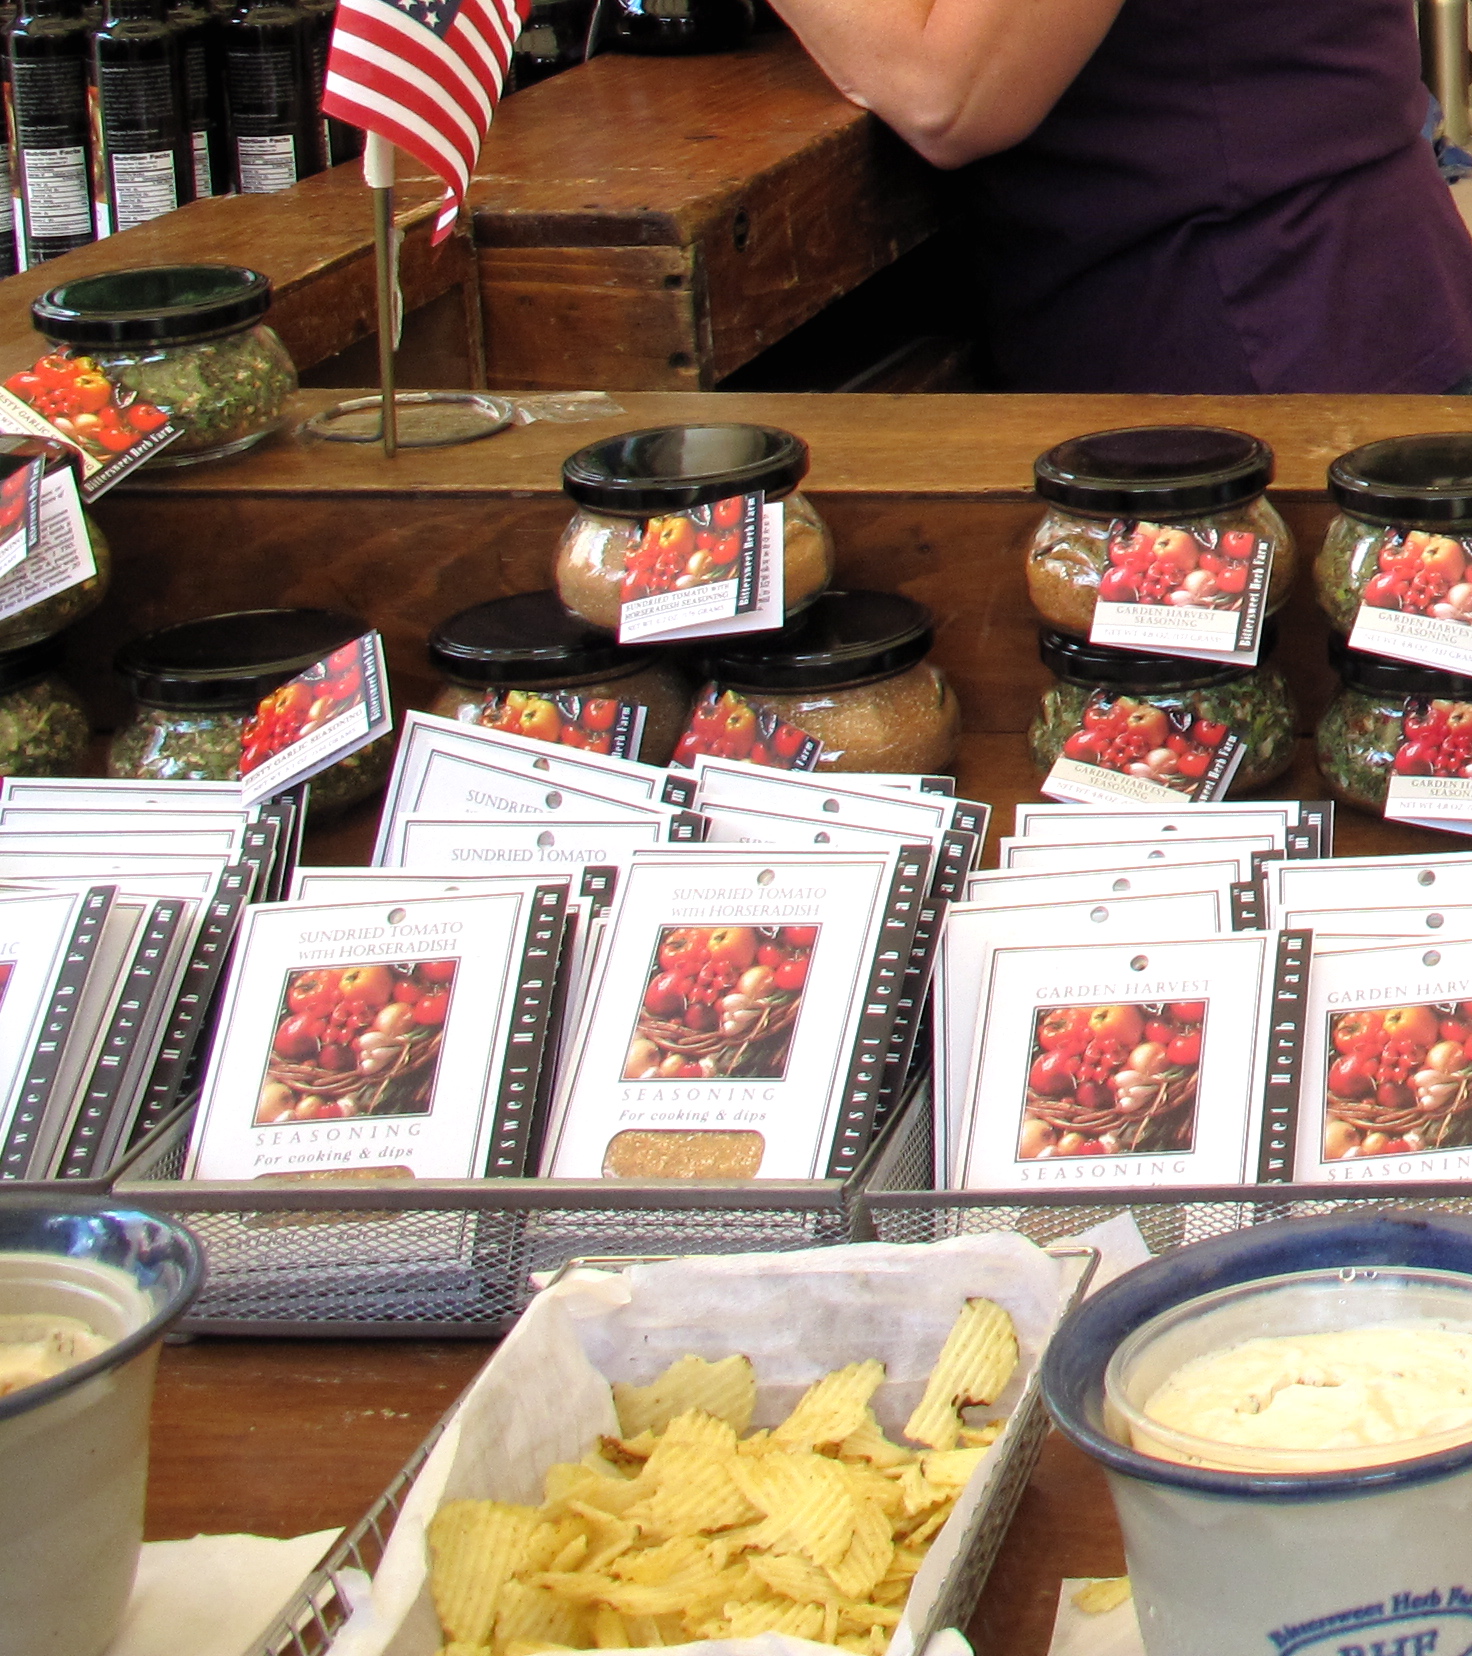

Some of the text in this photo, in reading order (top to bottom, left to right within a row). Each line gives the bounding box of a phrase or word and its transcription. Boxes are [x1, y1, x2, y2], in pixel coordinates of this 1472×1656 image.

[300, 921, 463, 943] SUNDRIED TOMATO
[339, 939, 457, 958] HORSERADISH
[1036, 978, 1211, 1000] GARDEN HARVEST
[256, 1123, 421, 1147] SEASONING
[254, 1145, 414, 1167] For cooking & dips
[1021, 1160, 1187, 1183] SEASONING
